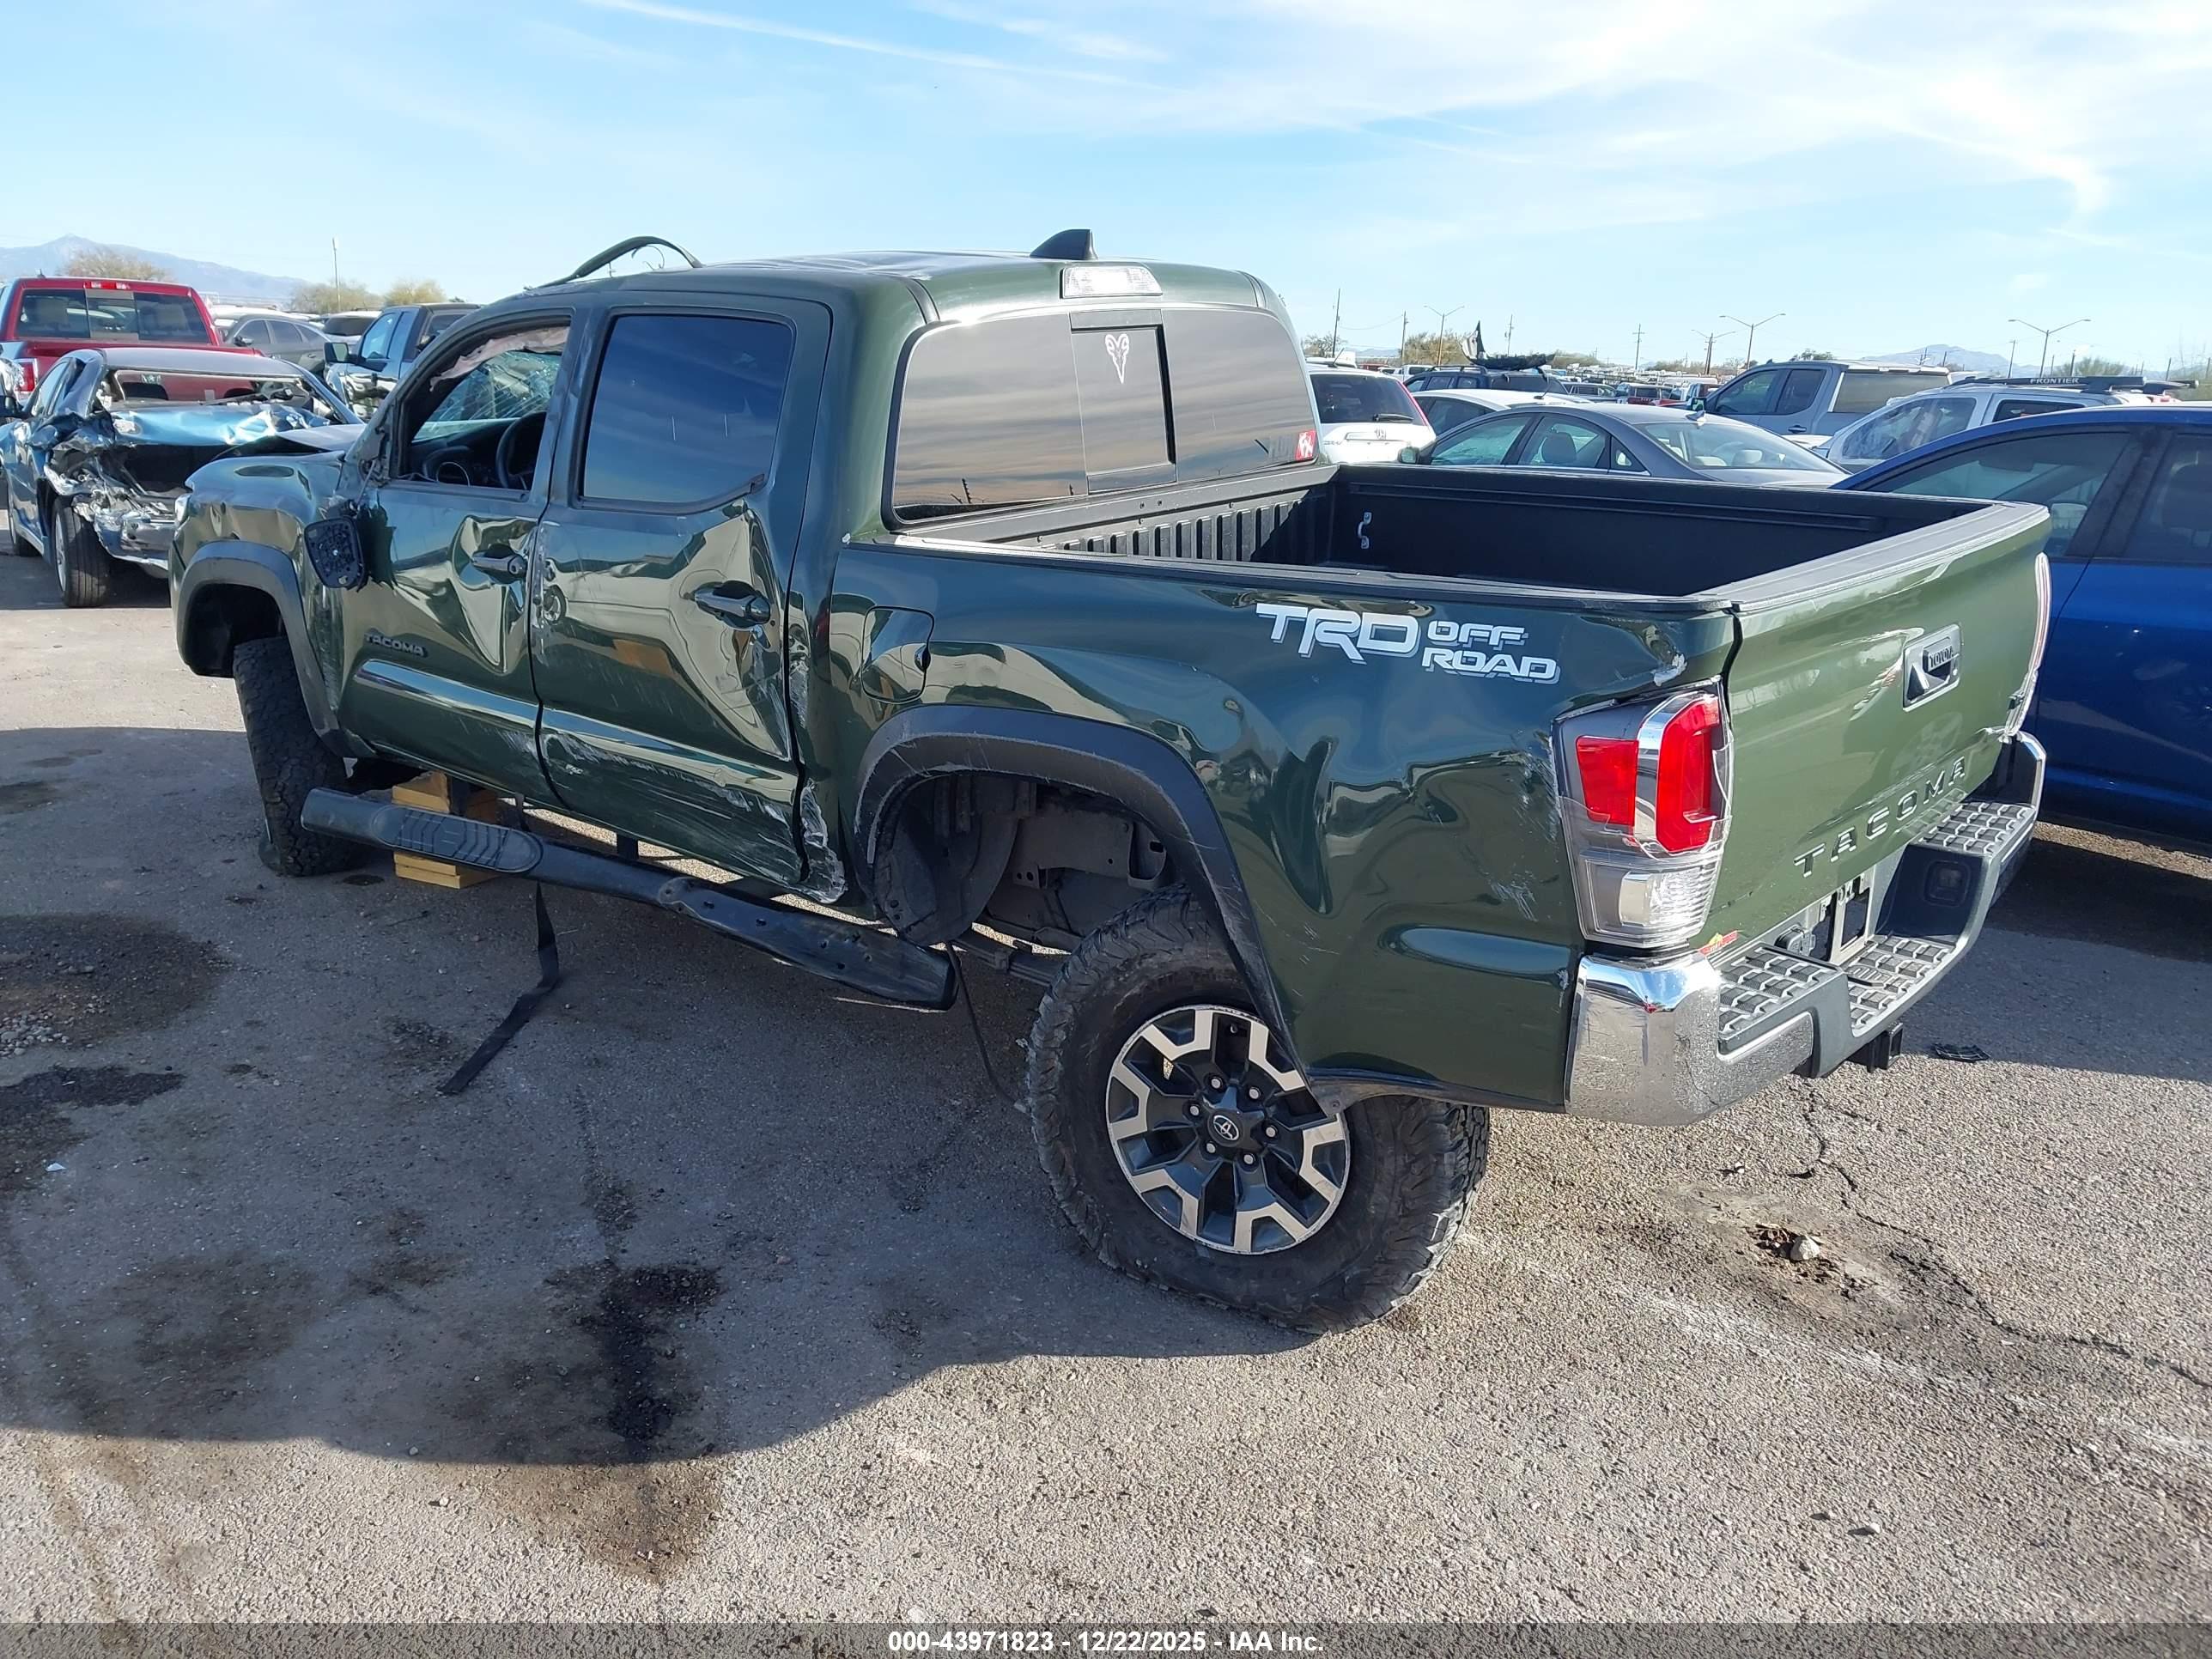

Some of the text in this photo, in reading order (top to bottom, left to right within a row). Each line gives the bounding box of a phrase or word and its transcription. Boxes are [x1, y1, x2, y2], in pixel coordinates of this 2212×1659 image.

[365, 633, 427, 657] TACOMA
[1256, 603, 1420, 665] TRD
[1427, 620, 1528, 650] OFF
[1421, 647, 1560, 684] ROAD
[1929, 646, 1954, 668] TOYOTA
[1794, 757, 1966, 878] TACOMA
